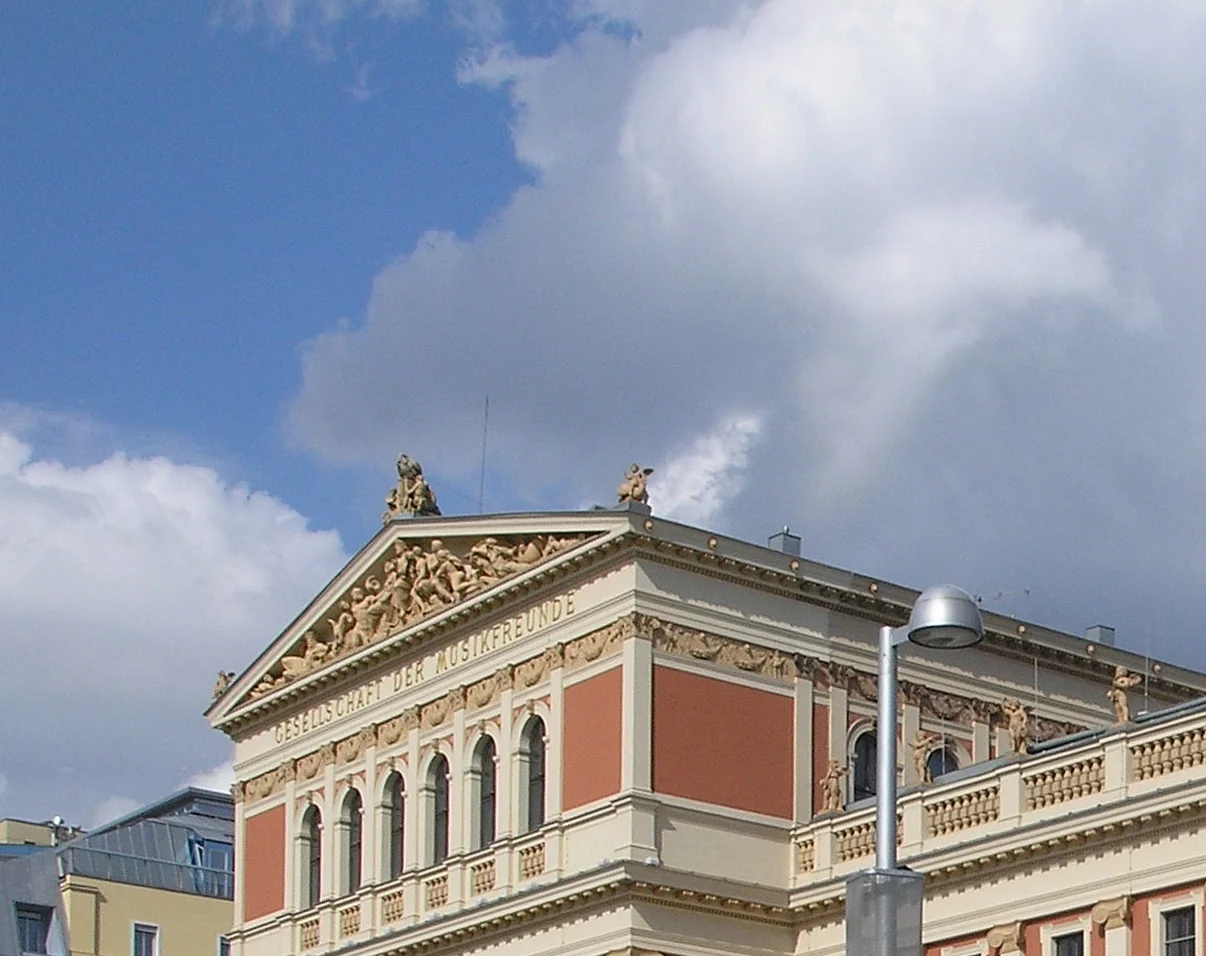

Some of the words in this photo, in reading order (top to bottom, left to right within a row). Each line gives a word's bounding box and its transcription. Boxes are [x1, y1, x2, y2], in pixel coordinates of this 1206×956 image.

[275, 680, 382, 744] GESELLSCHAFT
[393, 659, 425, 692] DER
[436, 593, 576, 674] MUSIKFREUNDE
